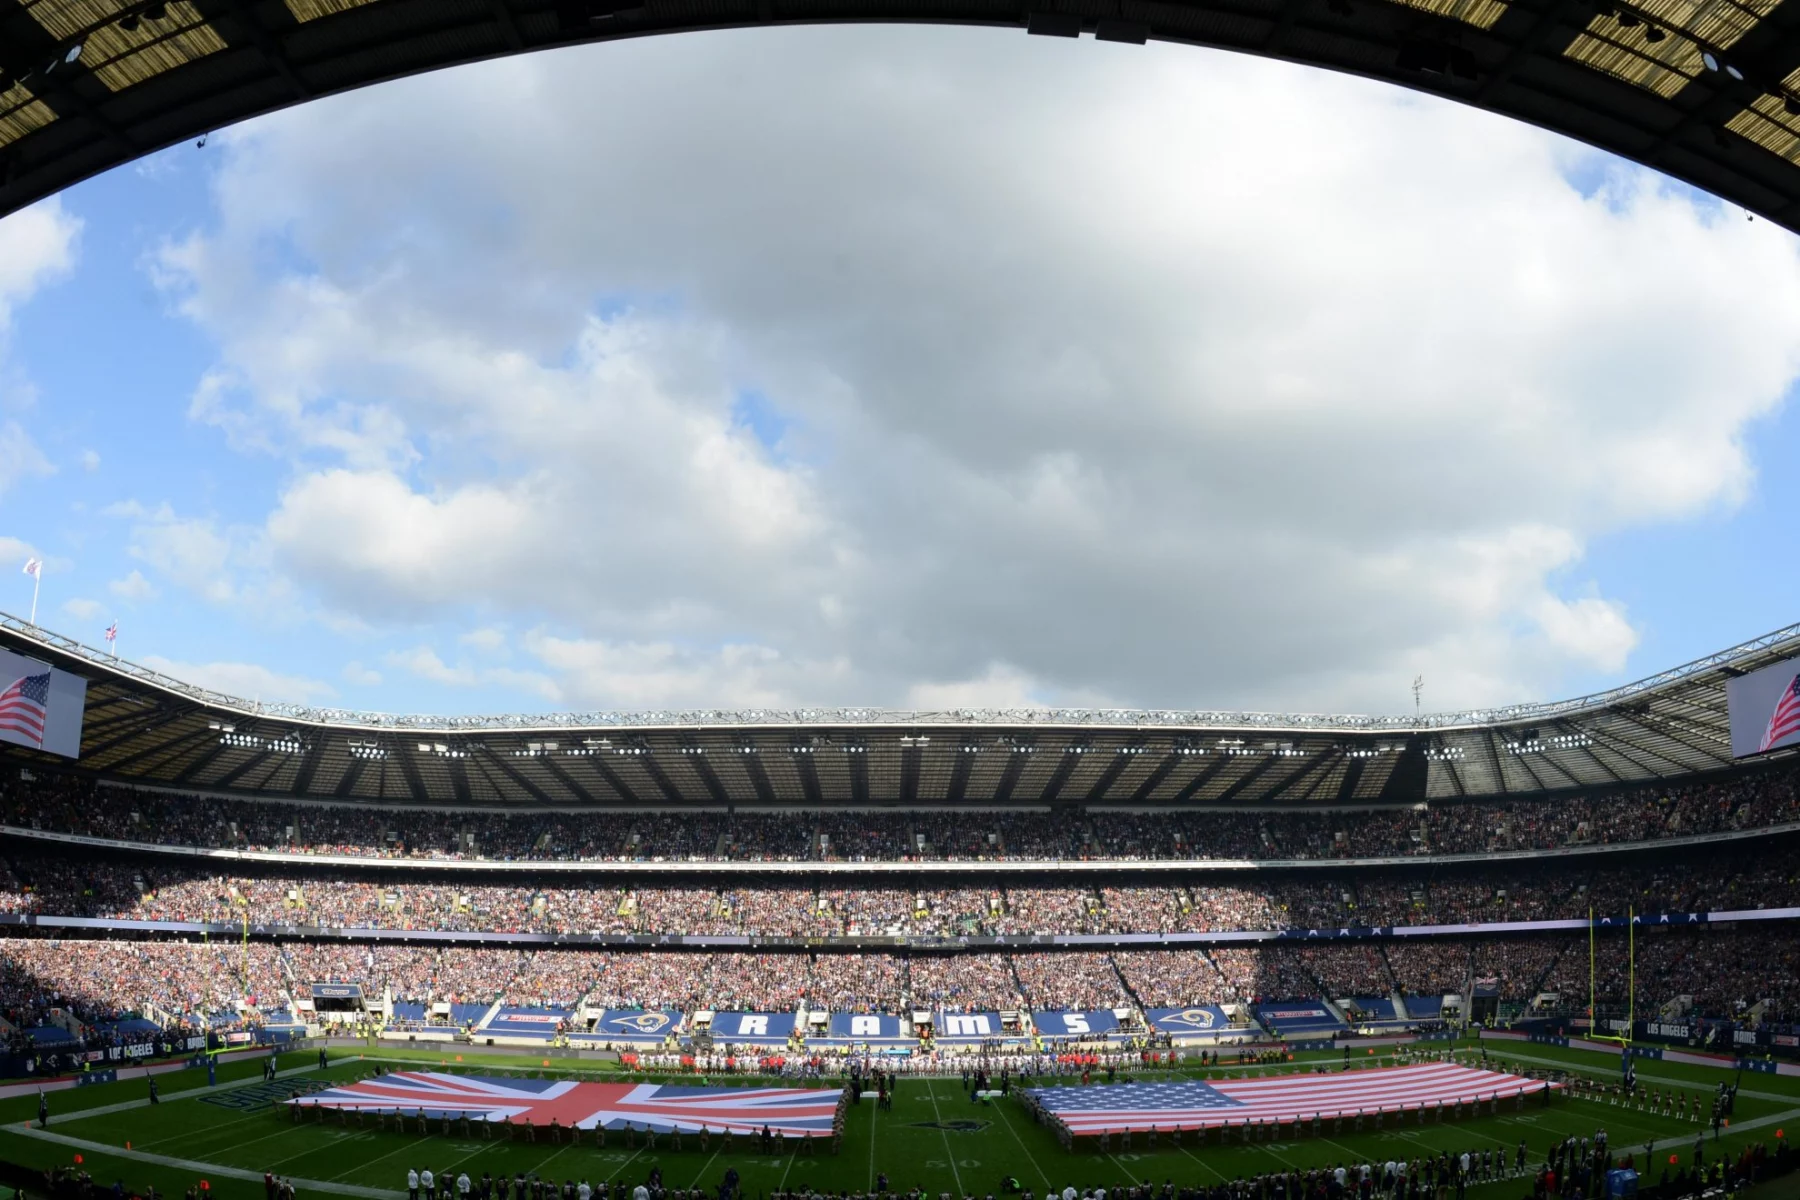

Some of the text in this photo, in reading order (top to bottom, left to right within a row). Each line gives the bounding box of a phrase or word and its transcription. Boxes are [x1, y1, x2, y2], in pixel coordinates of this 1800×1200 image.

[738, 1015, 768, 1035] R
[851, 1016, 879, 1035] A
[1647, 1023, 1690, 1038] LOS ANGELES
[187, 1036, 206, 1050] RAMS
[1733, 1031, 1756, 1044] RAMS
